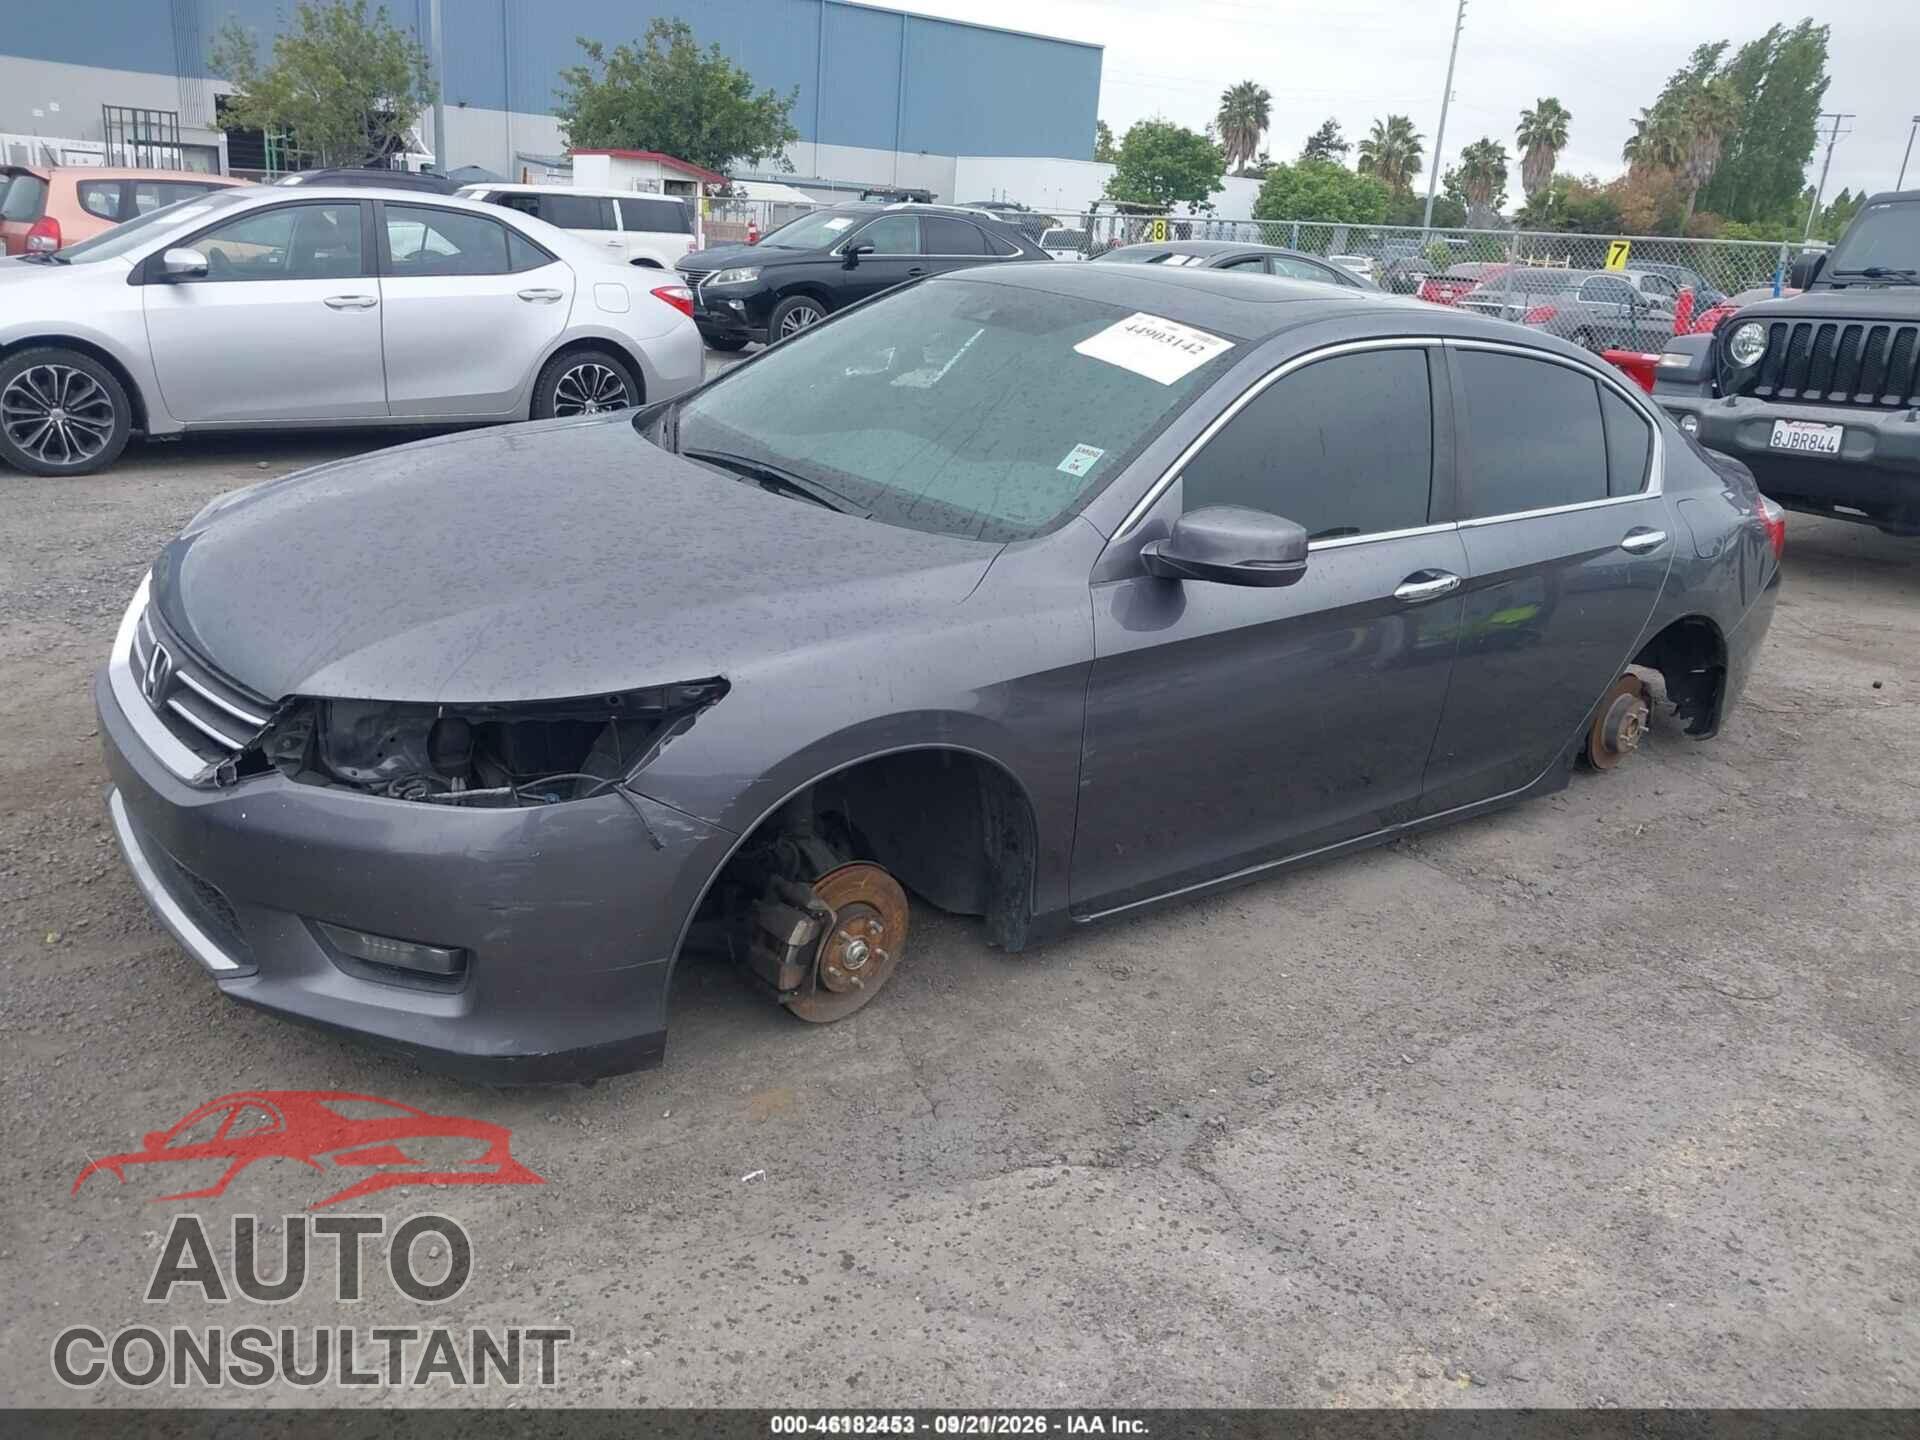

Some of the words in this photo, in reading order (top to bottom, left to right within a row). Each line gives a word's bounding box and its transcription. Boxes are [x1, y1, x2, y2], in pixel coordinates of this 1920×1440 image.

[1155, 222, 1164, 240] 8
[1612, 243, 1627, 266] 7
[1125, 324, 1205, 355] 44903142
[1772, 430, 1835, 452] 8JBR844
